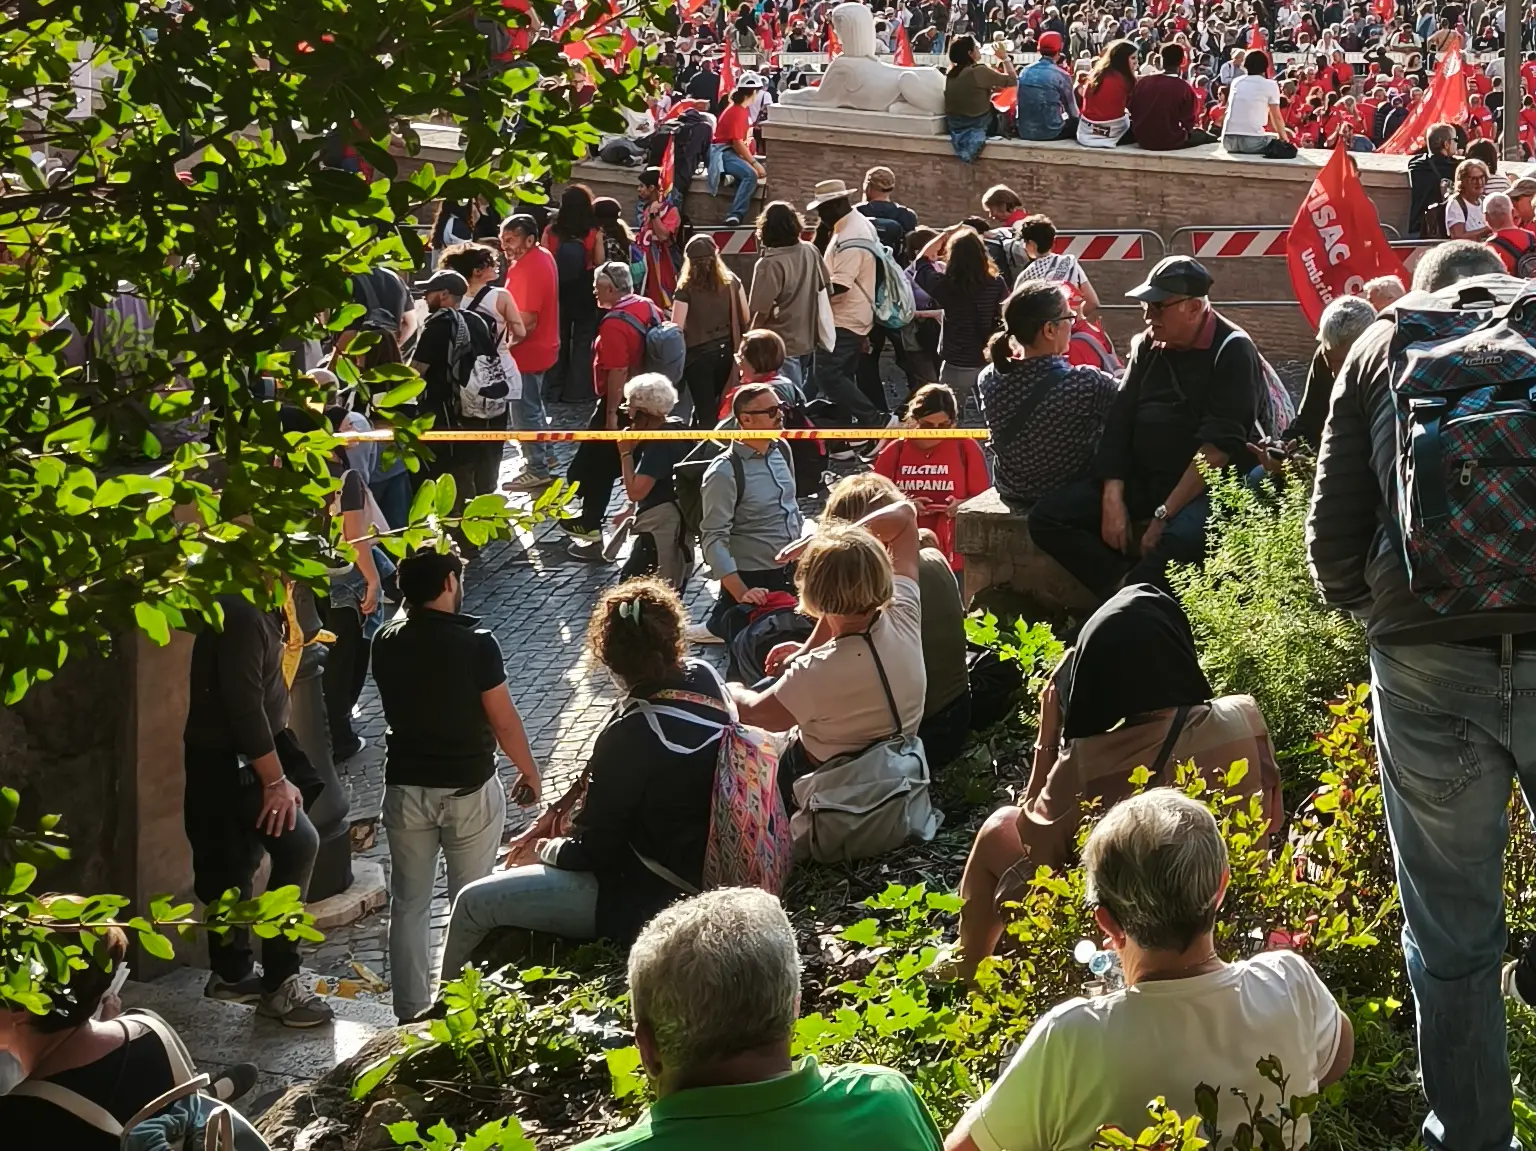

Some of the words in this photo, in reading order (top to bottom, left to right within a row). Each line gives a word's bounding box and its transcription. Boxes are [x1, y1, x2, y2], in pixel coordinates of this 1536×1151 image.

[1306, 178, 1351, 266] FISAC
[1301, 247, 1335, 306] Umbria
[896, 479, 955, 491] AMPANIA
[901, 464, 949, 475] FILCTEM
